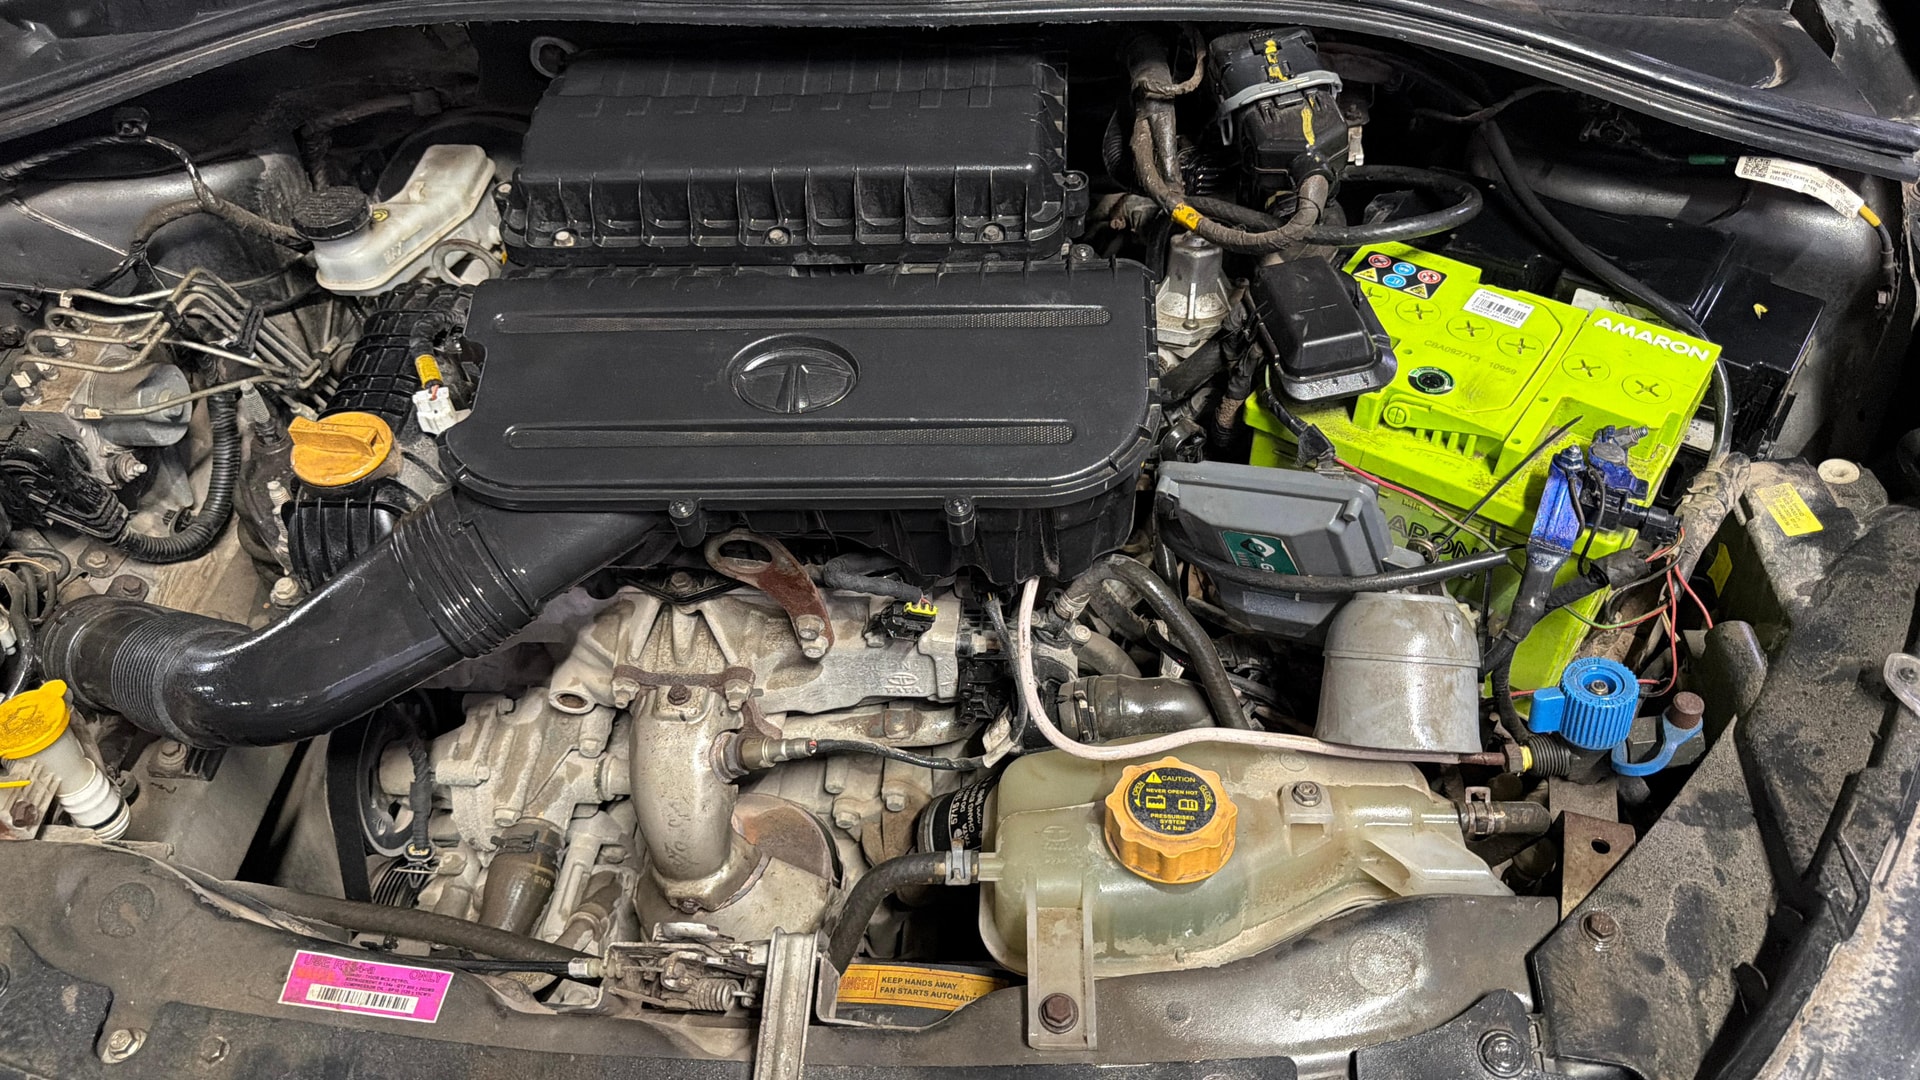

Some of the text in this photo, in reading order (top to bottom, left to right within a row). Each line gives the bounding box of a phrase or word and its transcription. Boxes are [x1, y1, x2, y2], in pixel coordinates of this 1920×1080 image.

[1593, 317, 1710, 362] AMARON
[1162, 775, 1196, 783] CAUTION
[1132, 781, 1146, 796] OPEN
[1199, 784, 1214, 804] CLOSE
[409, 970, 445, 984] ONLY
[839, 976, 876, 991] ANGER
[882, 976, 958, 990] KEEP HANDS AWAY
[898, 987, 930, 996] STARTS
